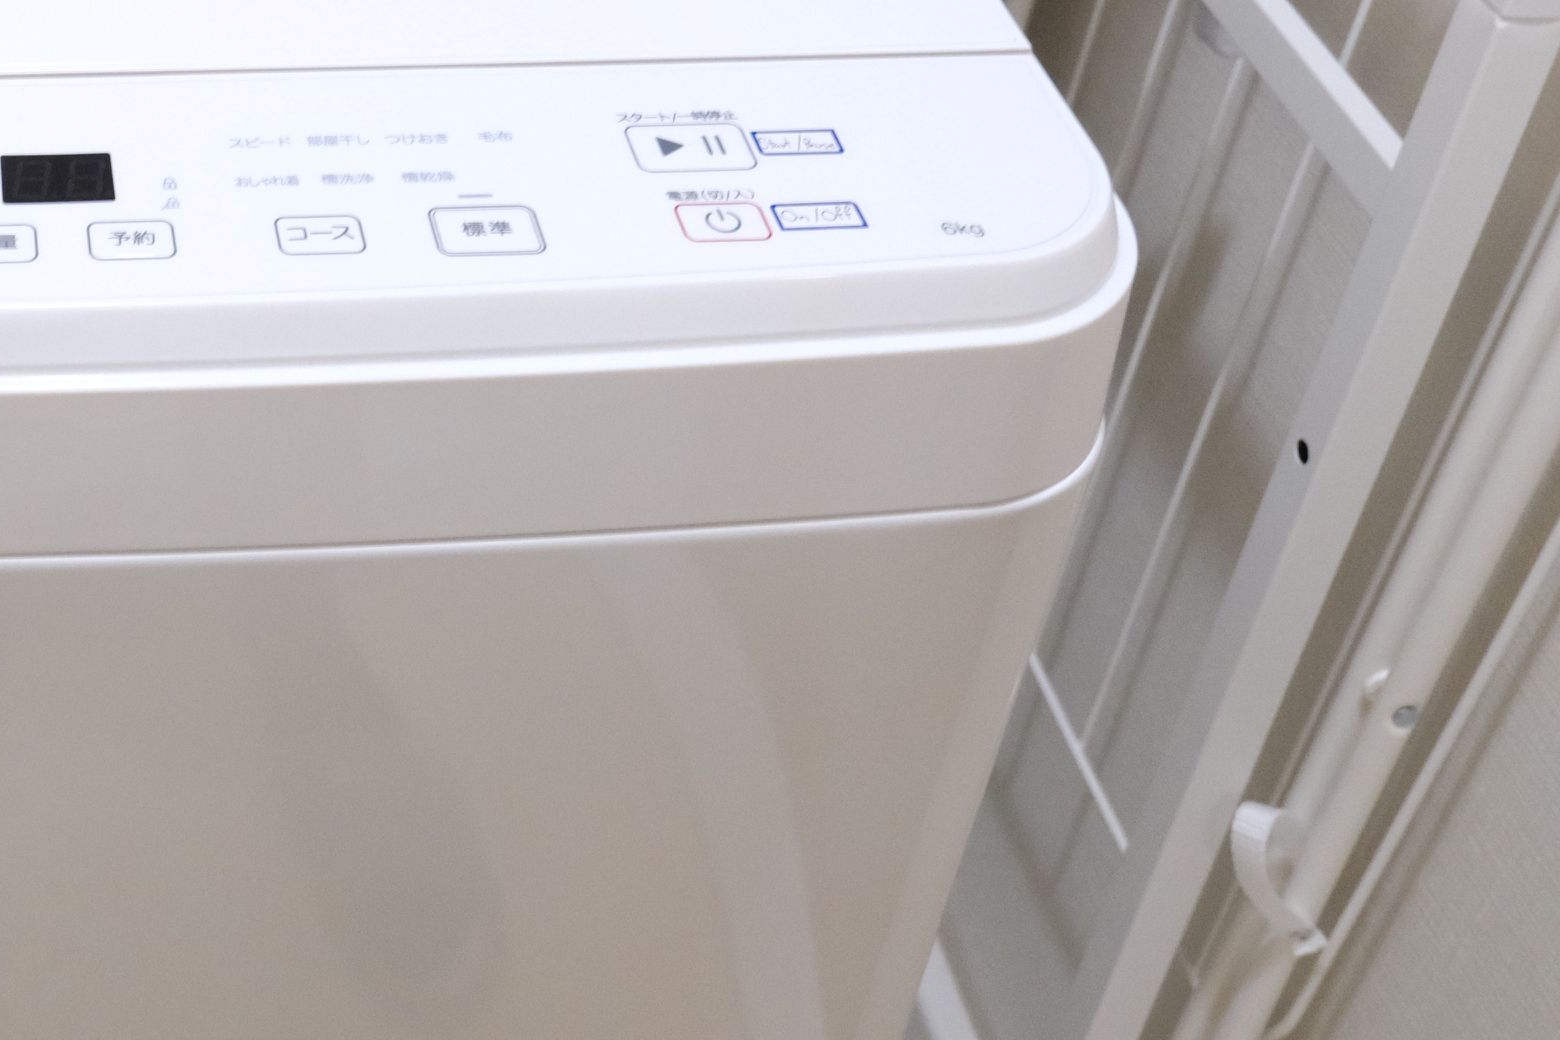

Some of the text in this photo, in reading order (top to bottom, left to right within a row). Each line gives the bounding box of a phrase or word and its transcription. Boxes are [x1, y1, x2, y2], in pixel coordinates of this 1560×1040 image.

[286, 225, 355, 241] コース
[461, 220, 513, 238] 標準
[939, 221, 986, 238] 6kg
[108, 230, 156, 247] 予約
